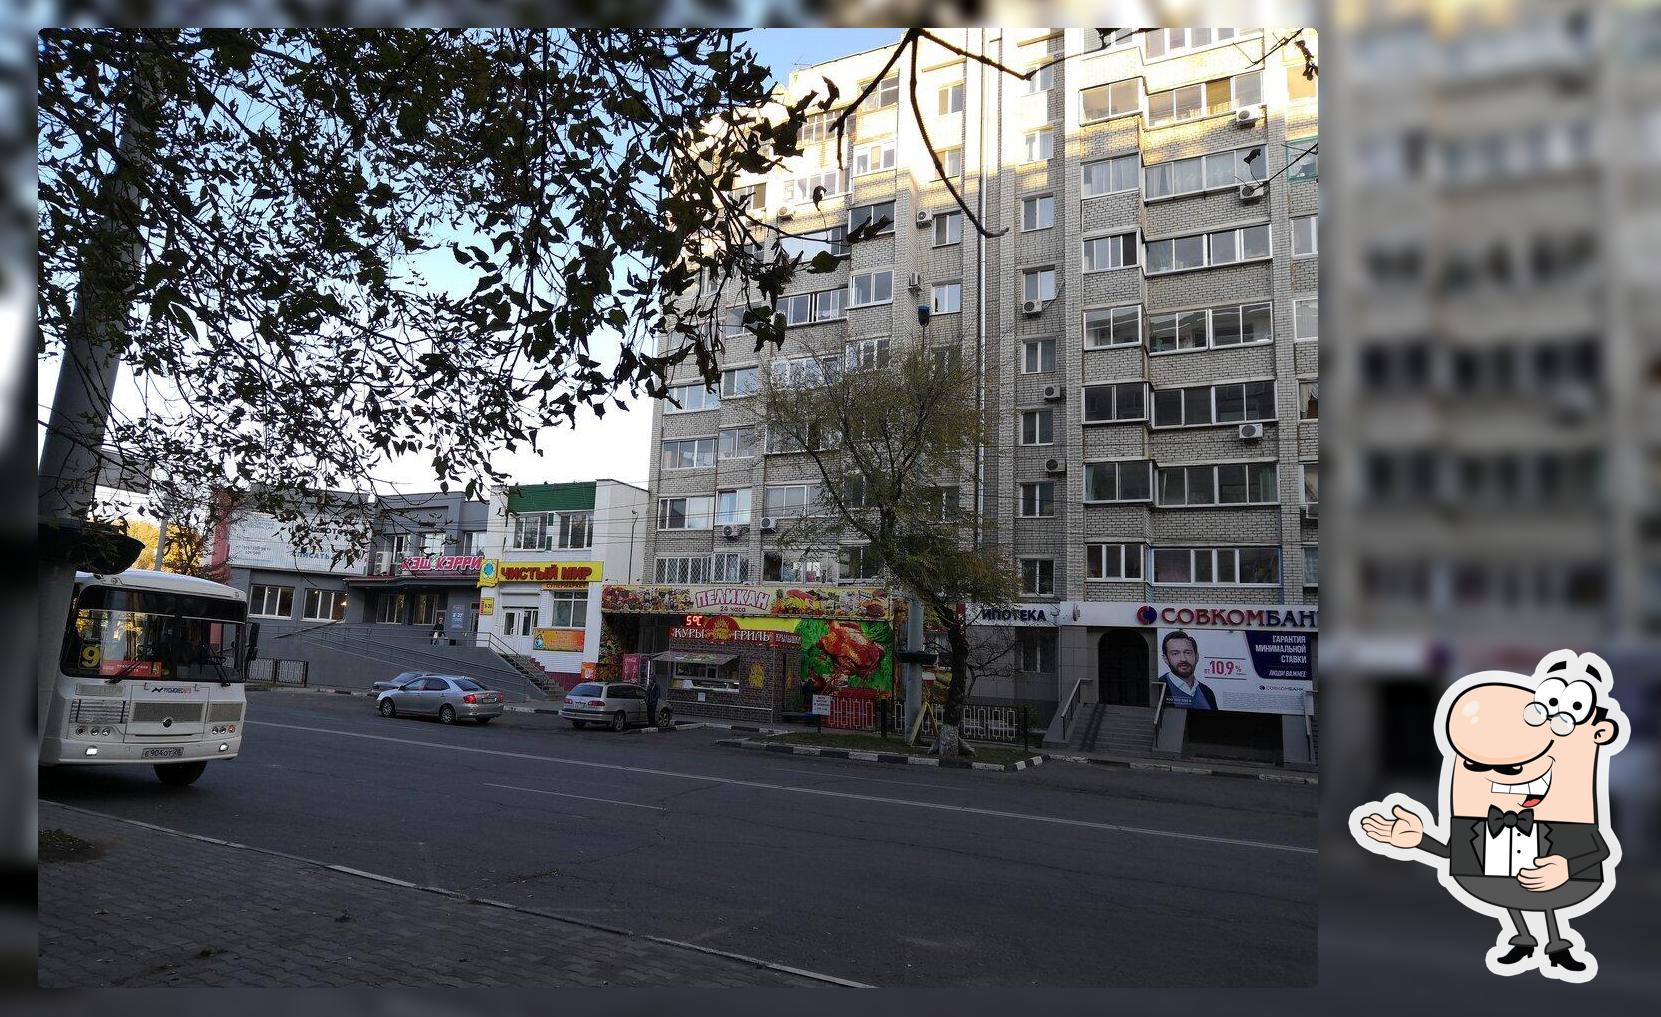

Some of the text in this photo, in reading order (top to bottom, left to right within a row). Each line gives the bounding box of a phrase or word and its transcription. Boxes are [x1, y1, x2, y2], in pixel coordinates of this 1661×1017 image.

[435, 556, 484, 571] КЭРРИ
[501, 564, 593, 580] ЧИСТЫЙ МИР
[695, 588, 771, 611] ПЕЛИКАН
[982, 608, 1047, 622] ИПОТЕКА
[1161, 607, 1318, 628] СОВКОМБАН
[673, 628, 771, 642] КУРЫ ГРИЛЬ
[1272, 635, 1306, 644] ГАРАНТИЯ
[1255, 644, 1307, 654] МИНИМАЛЬНОЙ
[82, 646, 101, 669] 9
[1281, 655, 1307, 664] СТАВКИ
